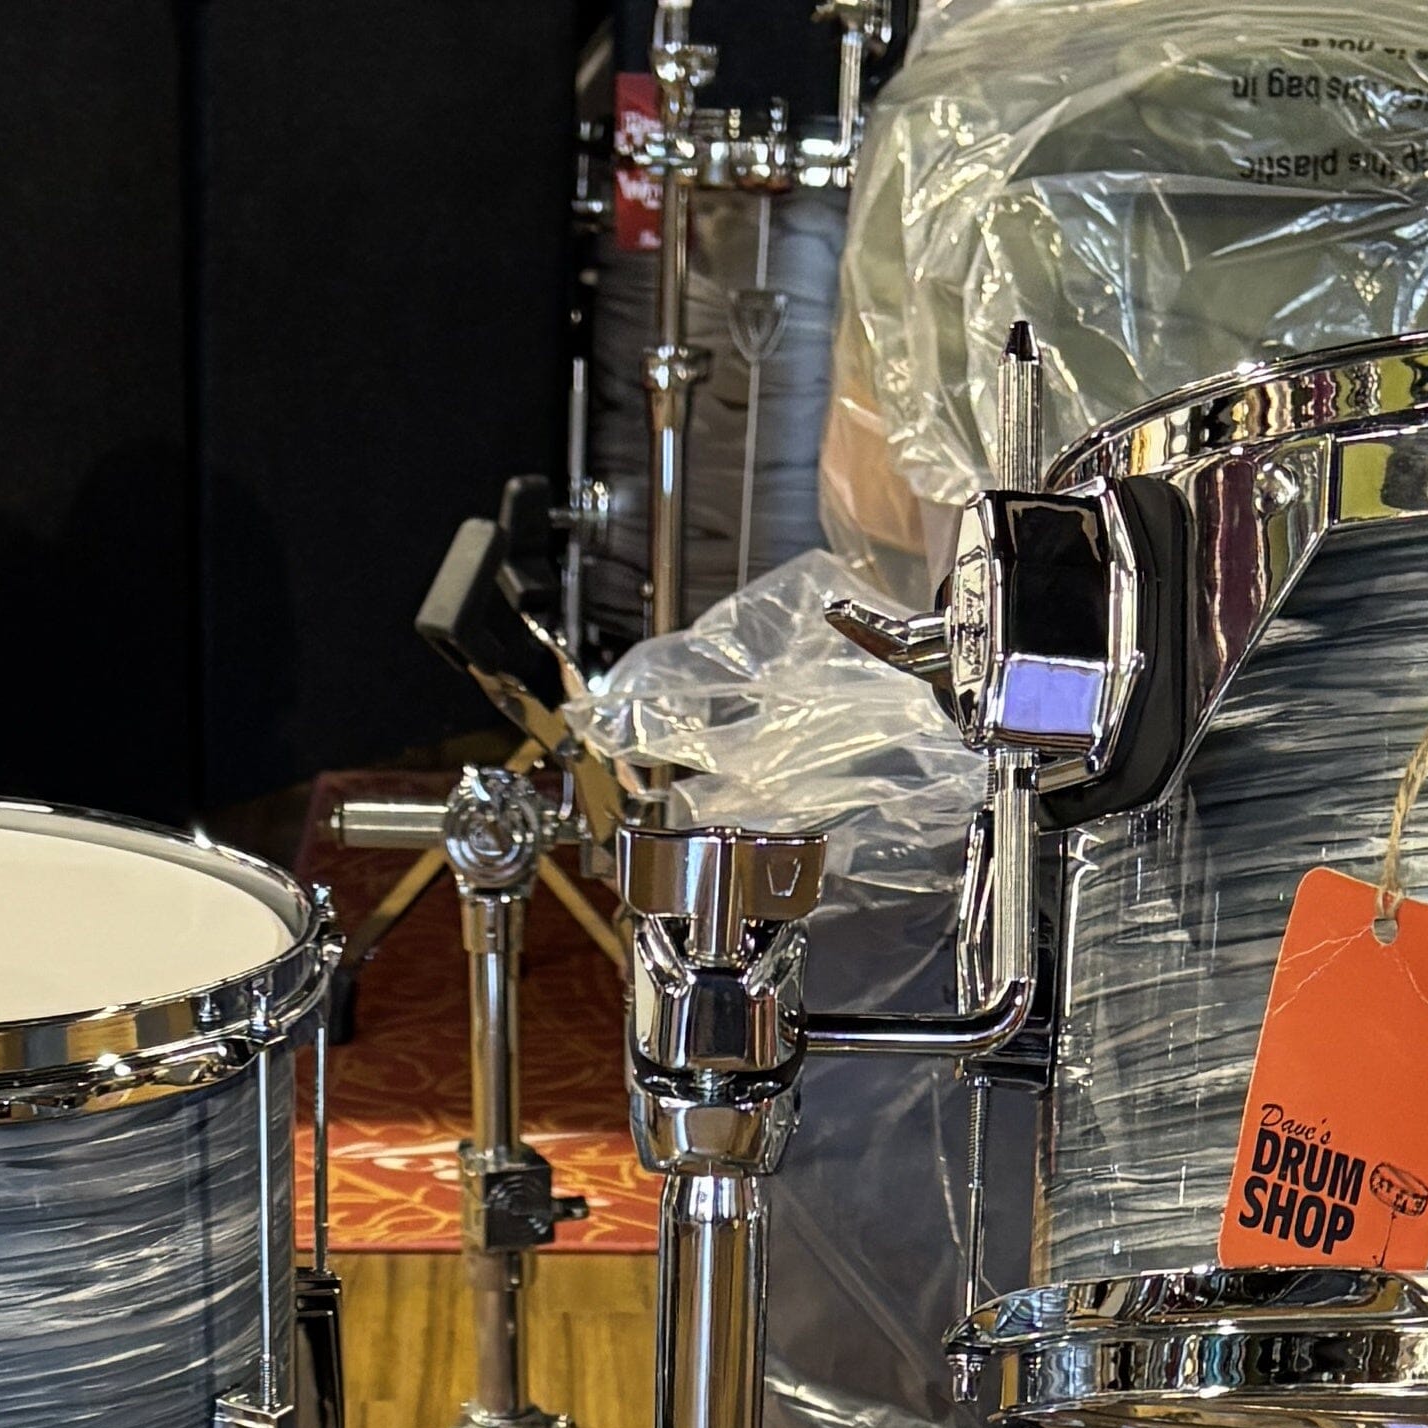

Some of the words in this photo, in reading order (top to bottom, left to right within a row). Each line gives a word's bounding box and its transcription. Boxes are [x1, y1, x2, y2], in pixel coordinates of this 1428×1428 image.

[1232, 78, 1258, 108] in
[1267, 68, 1321, 105] bag
[1239, 148, 1339, 185] plastic
[1260, 1102, 1332, 1145] Dave's
[1251, 1127, 1367, 1206] DRUM
[1238, 1176, 1355, 1255] SHOP
